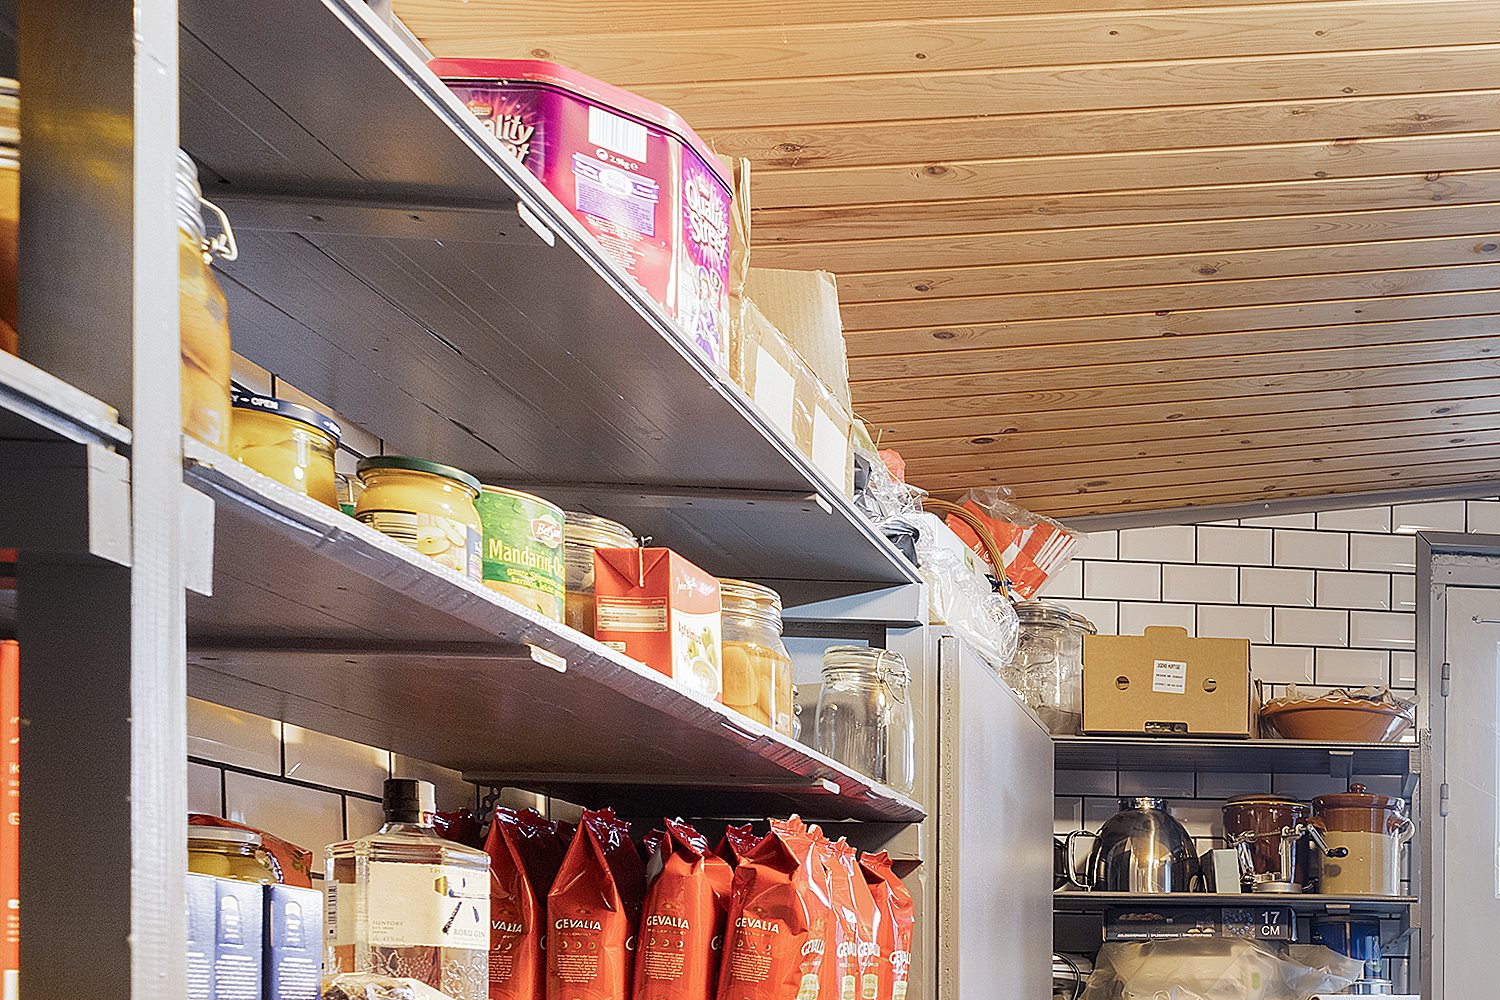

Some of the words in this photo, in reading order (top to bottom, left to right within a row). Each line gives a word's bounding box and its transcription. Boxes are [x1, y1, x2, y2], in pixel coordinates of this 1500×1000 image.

[482, 114, 534, 145] ality
[685, 179, 728, 240] Quality
[691, 212, 727, 260] Street
[646, 915, 690, 930] GEVALIA
[1261, 911, 1281, 924] 17
[491, 920, 522, 933] VALIA
[555, 919, 602, 931] GEVALIA
[735, 917, 780, 934] GEVALIA
[1261, 925, 1281, 936] CM
[453, 928, 473, 938] ROKU
[474, 930, 486, 938] GIN
